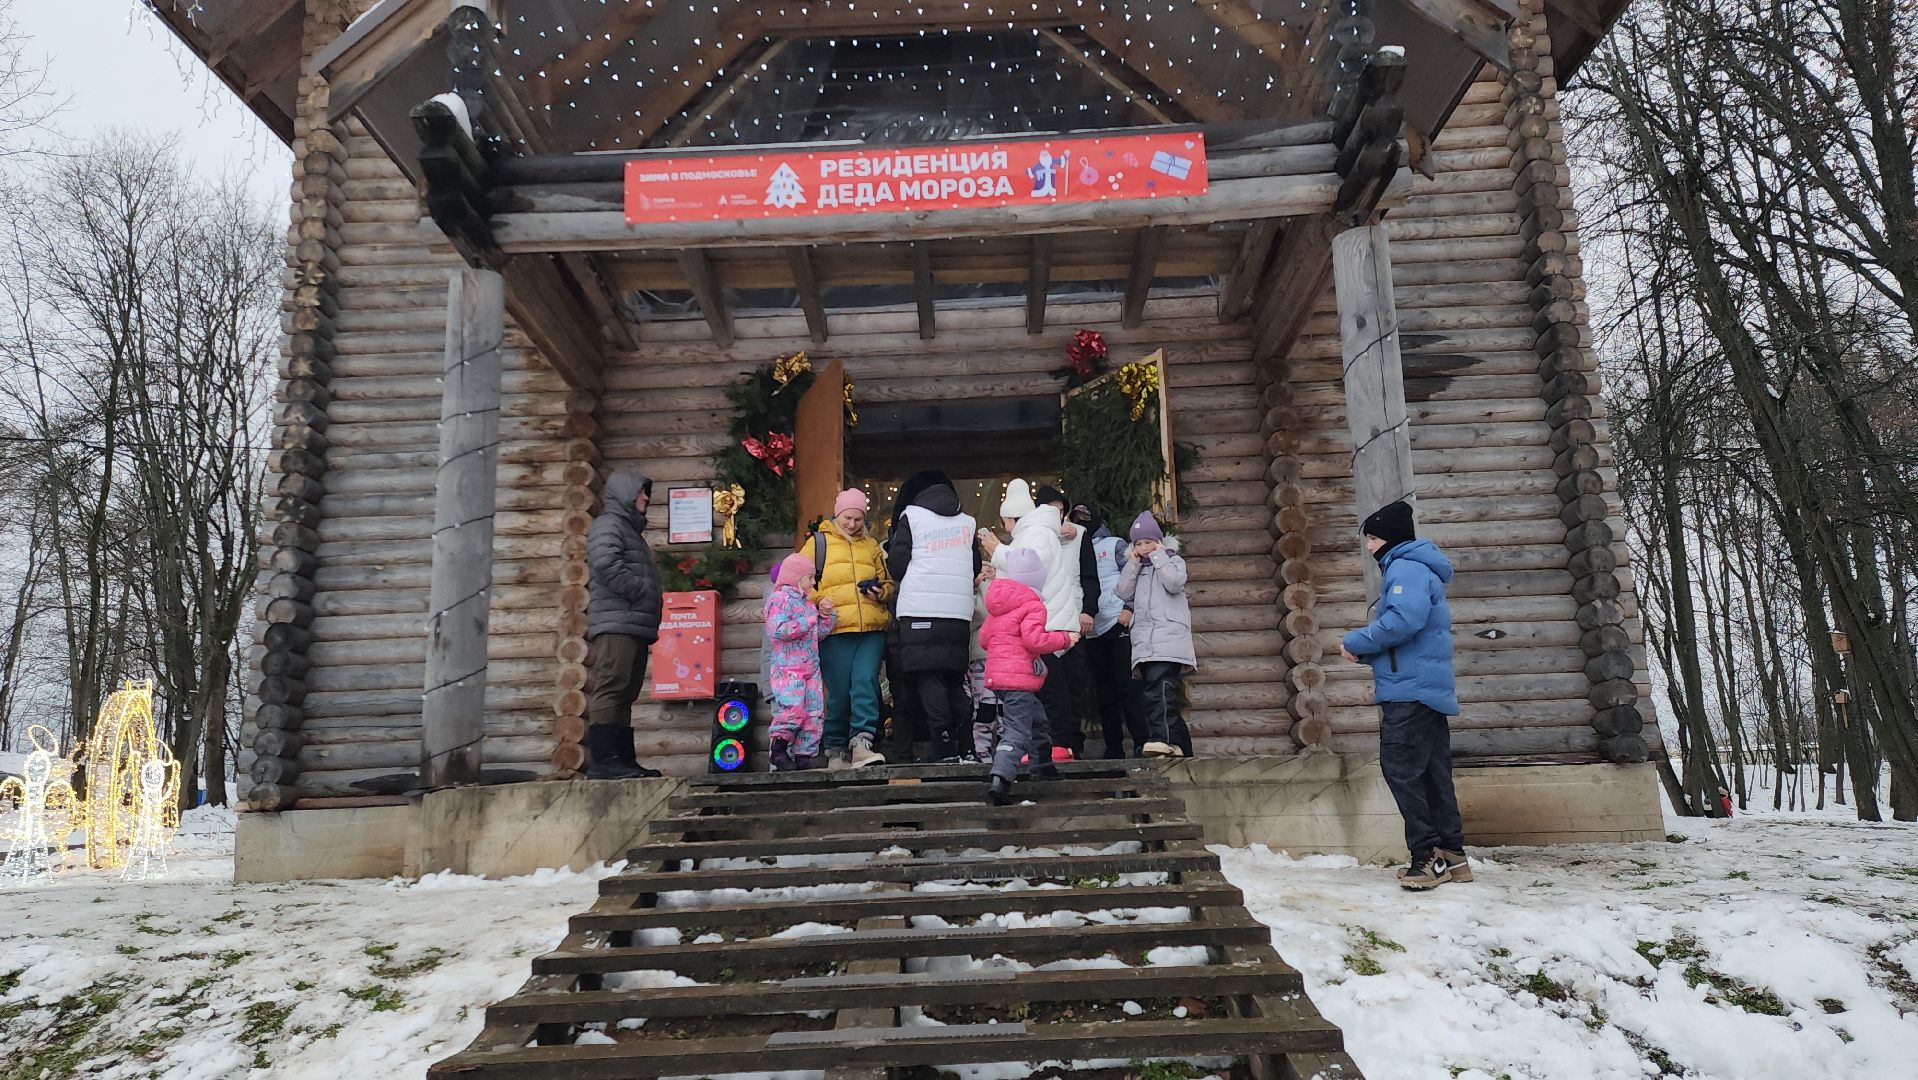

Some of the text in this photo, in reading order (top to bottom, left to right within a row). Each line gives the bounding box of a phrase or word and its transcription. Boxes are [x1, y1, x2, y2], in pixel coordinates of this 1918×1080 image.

[679, 167, 758, 182] ПОДМОСКОВЬЕ
[820, 150, 1008, 178] РЕЗИДЕНЦИЯ
[817, 175, 1014, 208] ДЕДА МОРОЗА
[670, 612, 698, 621] ПОЧТА
